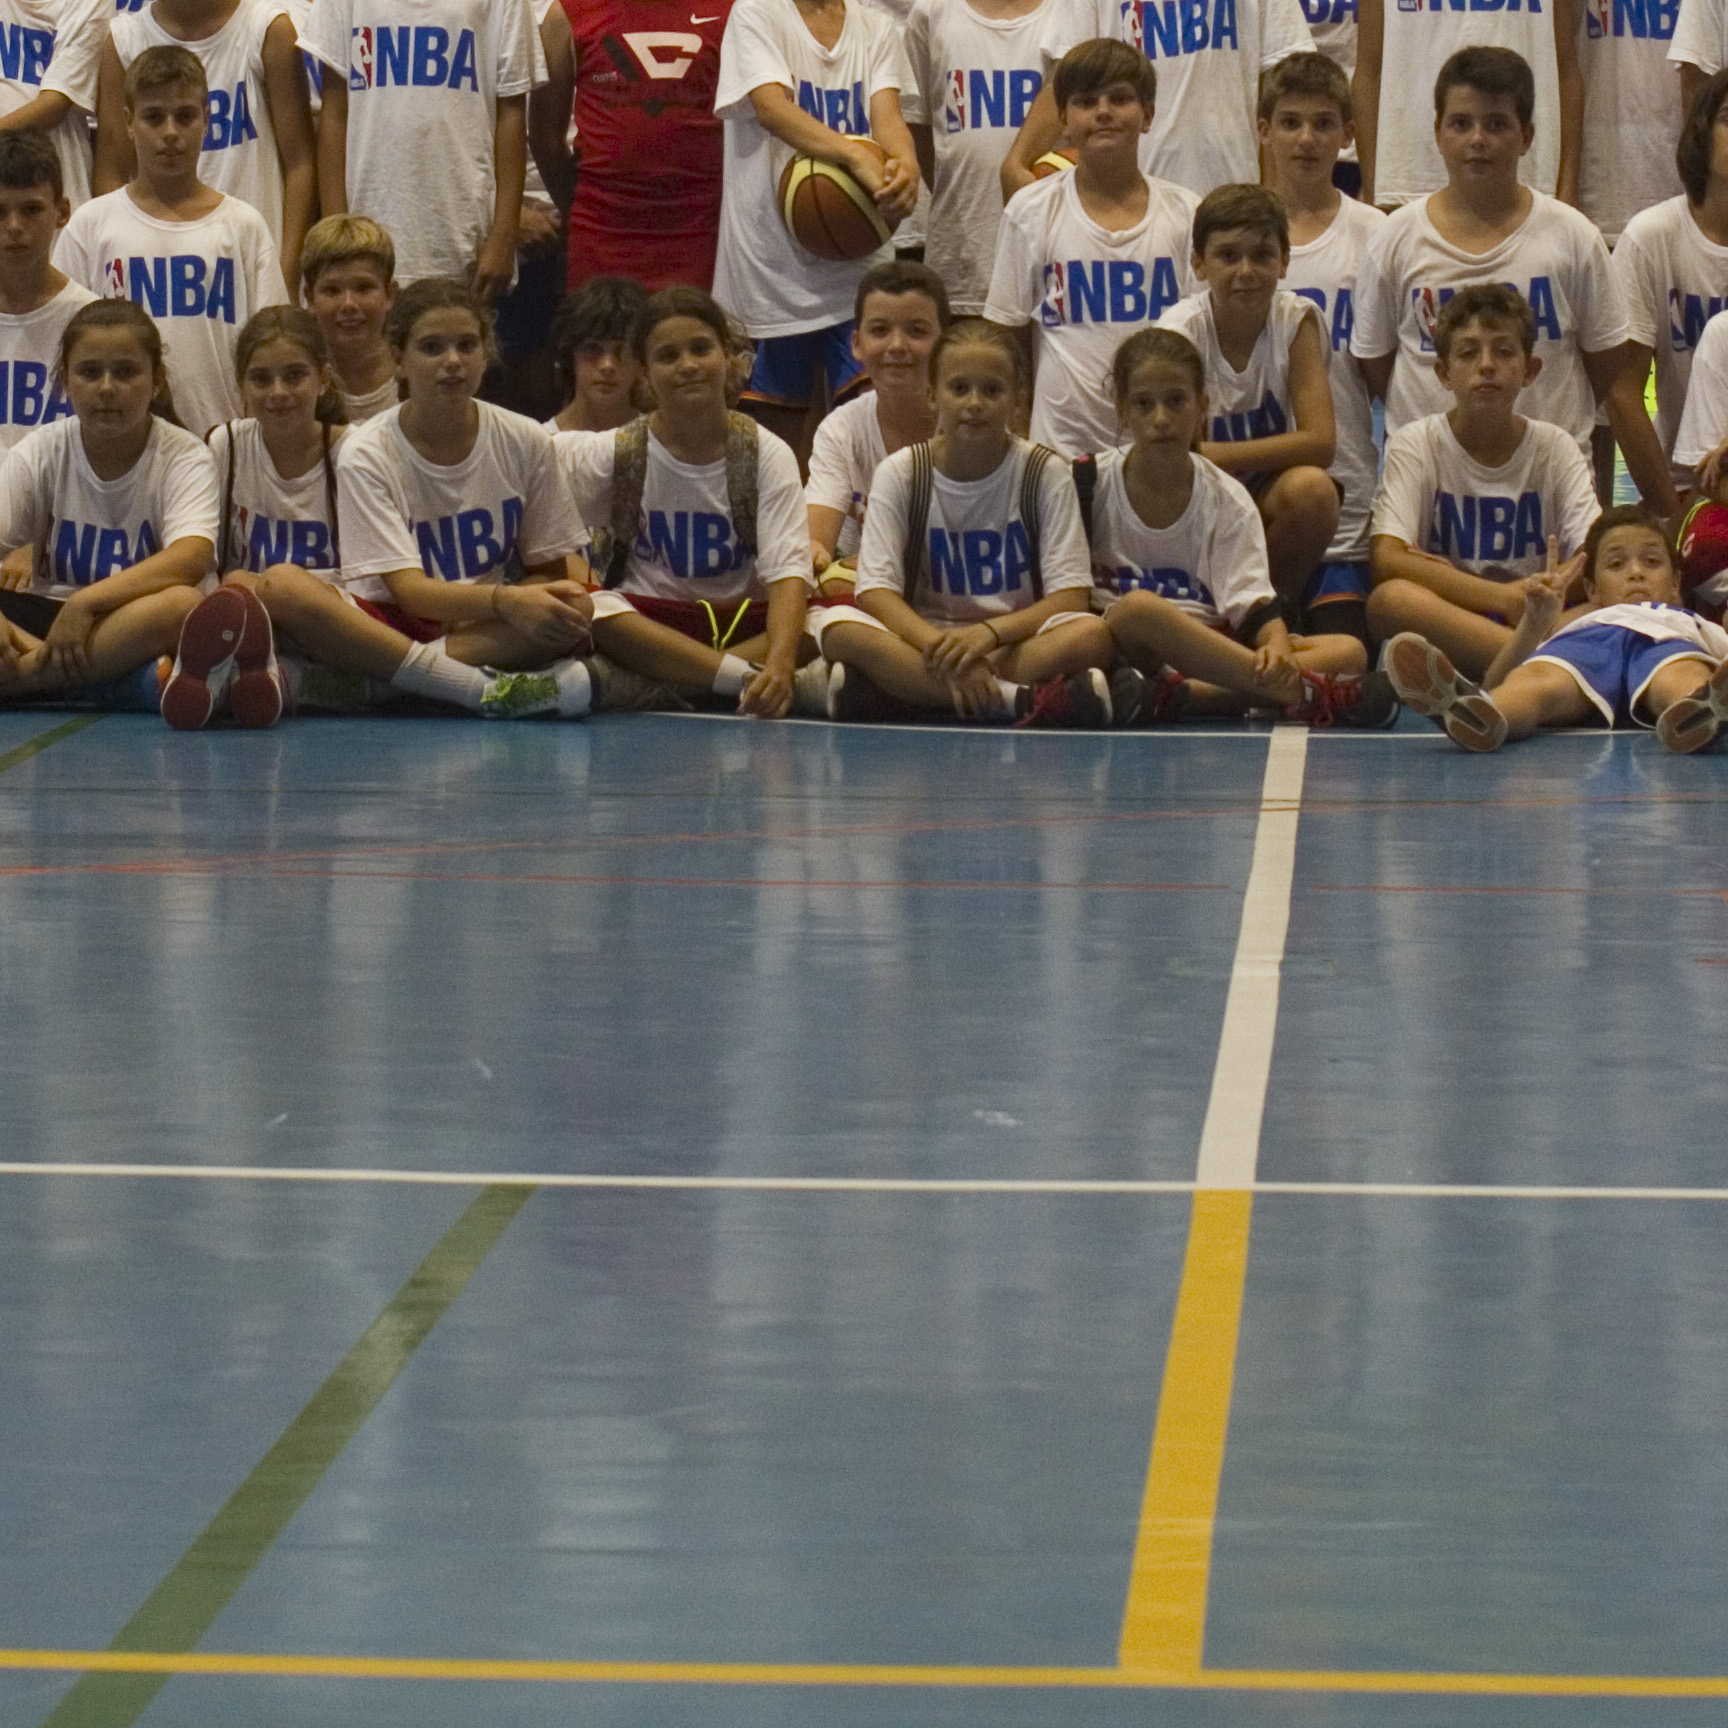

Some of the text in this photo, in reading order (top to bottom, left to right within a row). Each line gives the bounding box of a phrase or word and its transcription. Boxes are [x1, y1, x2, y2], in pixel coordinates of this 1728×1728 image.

[374, 26, 479, 92] NBA
[201, 81, 260, 152] BA
[972, 70, 1043, 129] NB
[128, 255, 236, 324] NBA
[1066, 257, 1179, 324] NBA
[418, 497, 523, 581] NBA
[928, 519, 1035, 597] NBA
[1439, 491, 1546, 562] NBA
